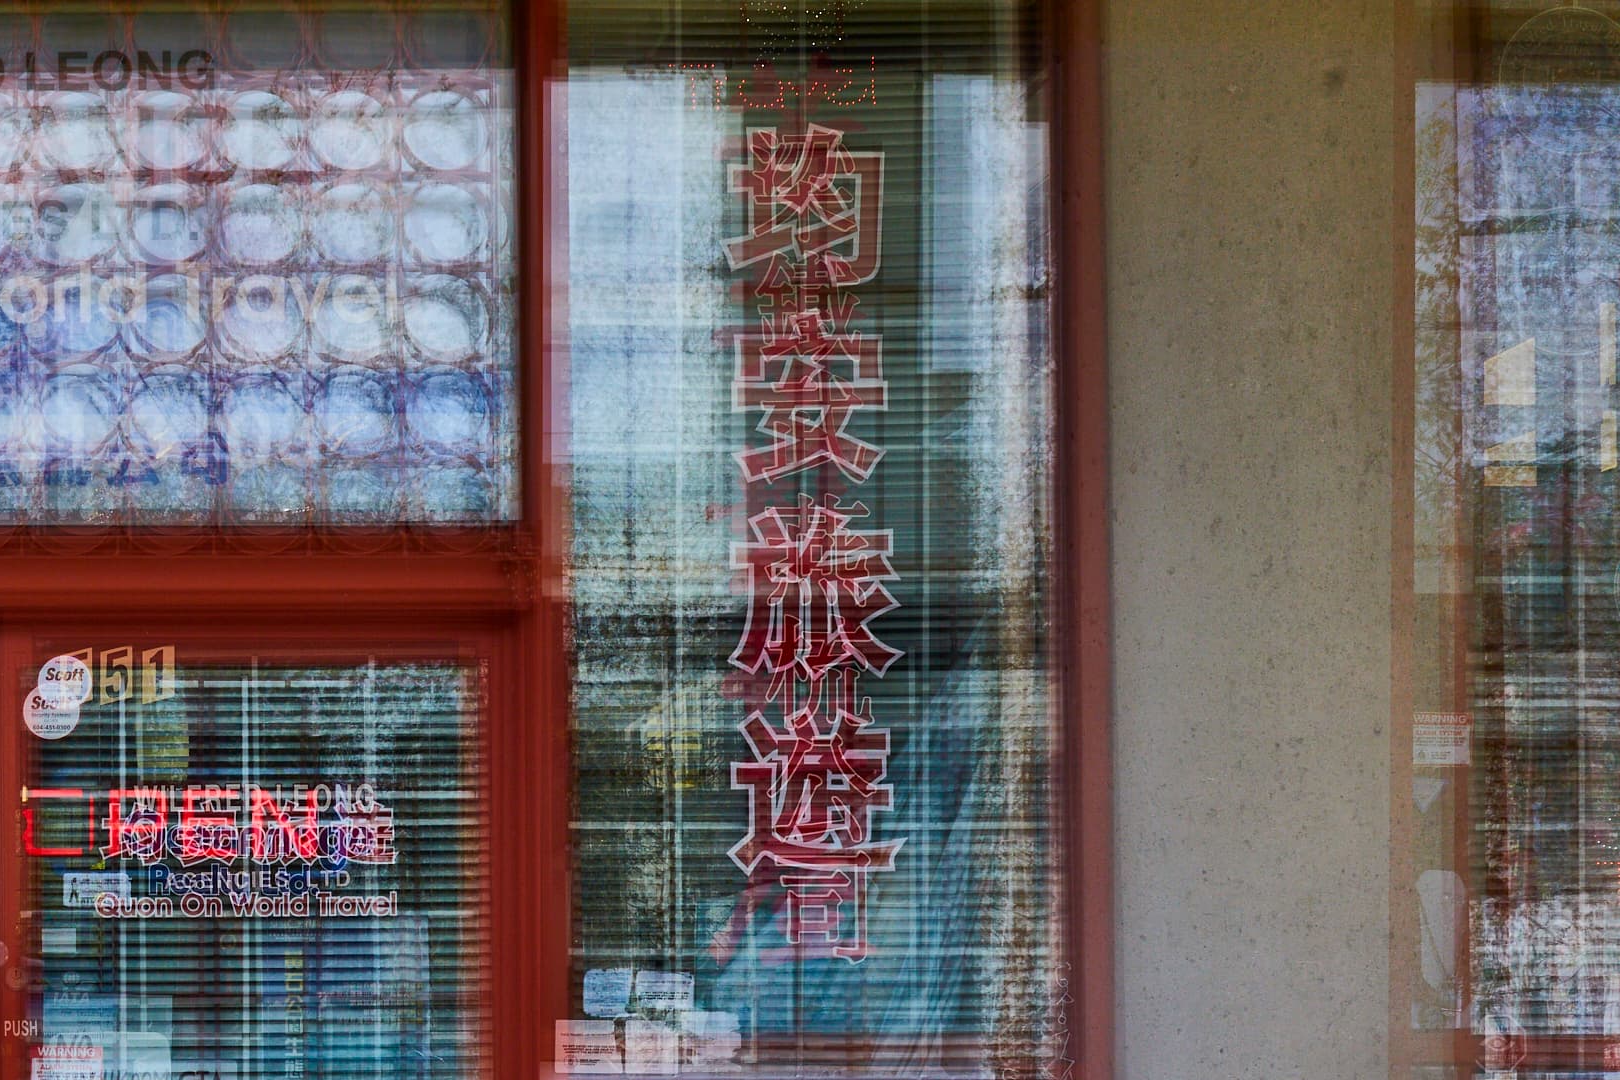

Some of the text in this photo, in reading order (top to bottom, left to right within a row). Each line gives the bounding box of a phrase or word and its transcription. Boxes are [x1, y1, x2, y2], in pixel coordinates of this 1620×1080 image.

[26, 50, 216, 91] LEONG
[183, 261, 397, 324] Travel
[45, 667, 85, 682] Scott
[1412, 714, 1467, 724] WARNING
[133, 783, 377, 813] WILFRED LEONG
[94, 891, 174, 918] Quon
[180, 891, 223, 918] On
[228, 891, 309, 918] World
[314, 891, 398, 917] Travel
[3, 1019, 37, 1037] PUSH
[37, 1046, 96, 1057] WARNING
